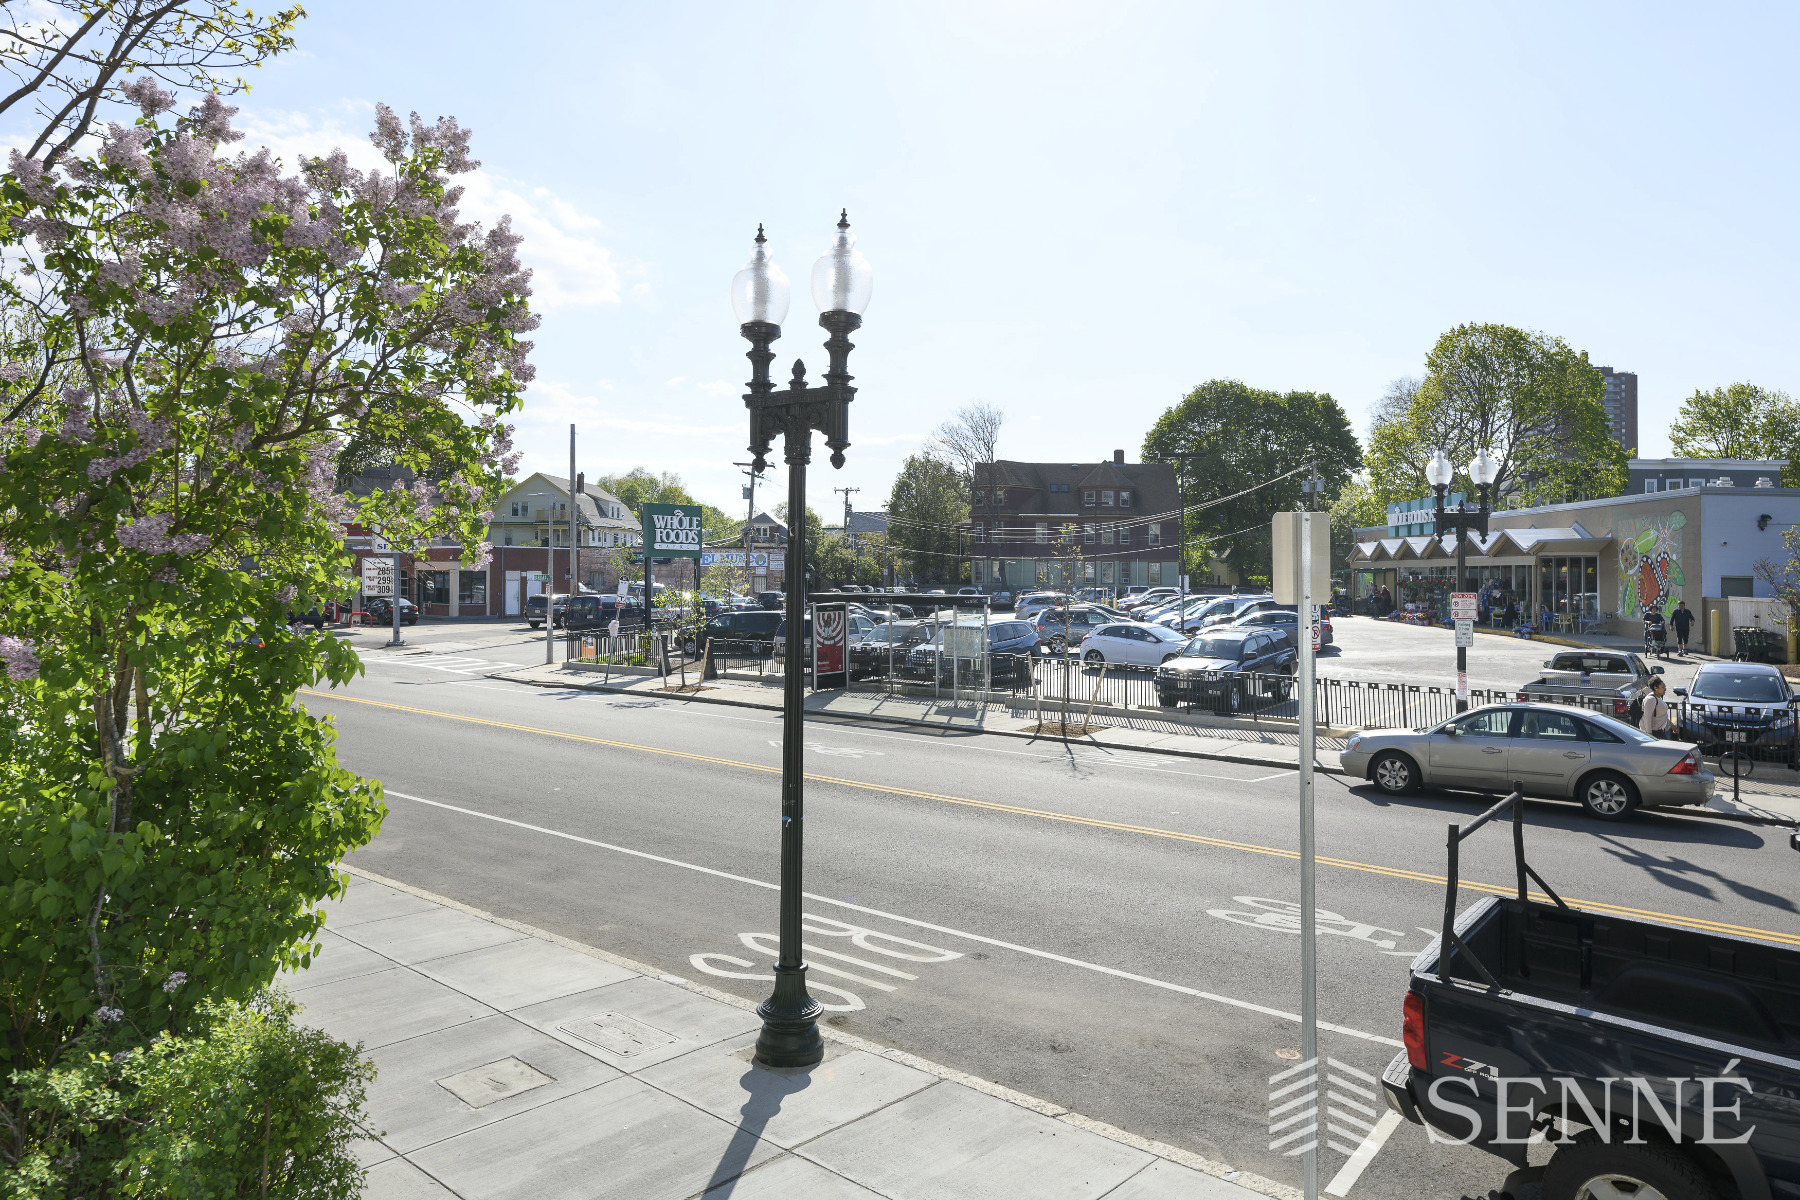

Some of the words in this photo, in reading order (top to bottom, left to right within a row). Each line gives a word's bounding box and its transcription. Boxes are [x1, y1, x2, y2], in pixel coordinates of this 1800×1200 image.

[652, 514, 701, 530] WHOLE
[1386, 511, 1408, 526] WHOLE
[1408, 509, 1429, 524] FOODS
[655, 529, 699, 544] FOODS
[689, 912, 964, 1011] BUS
[1440, 1051, 1499, 1078] Z71
